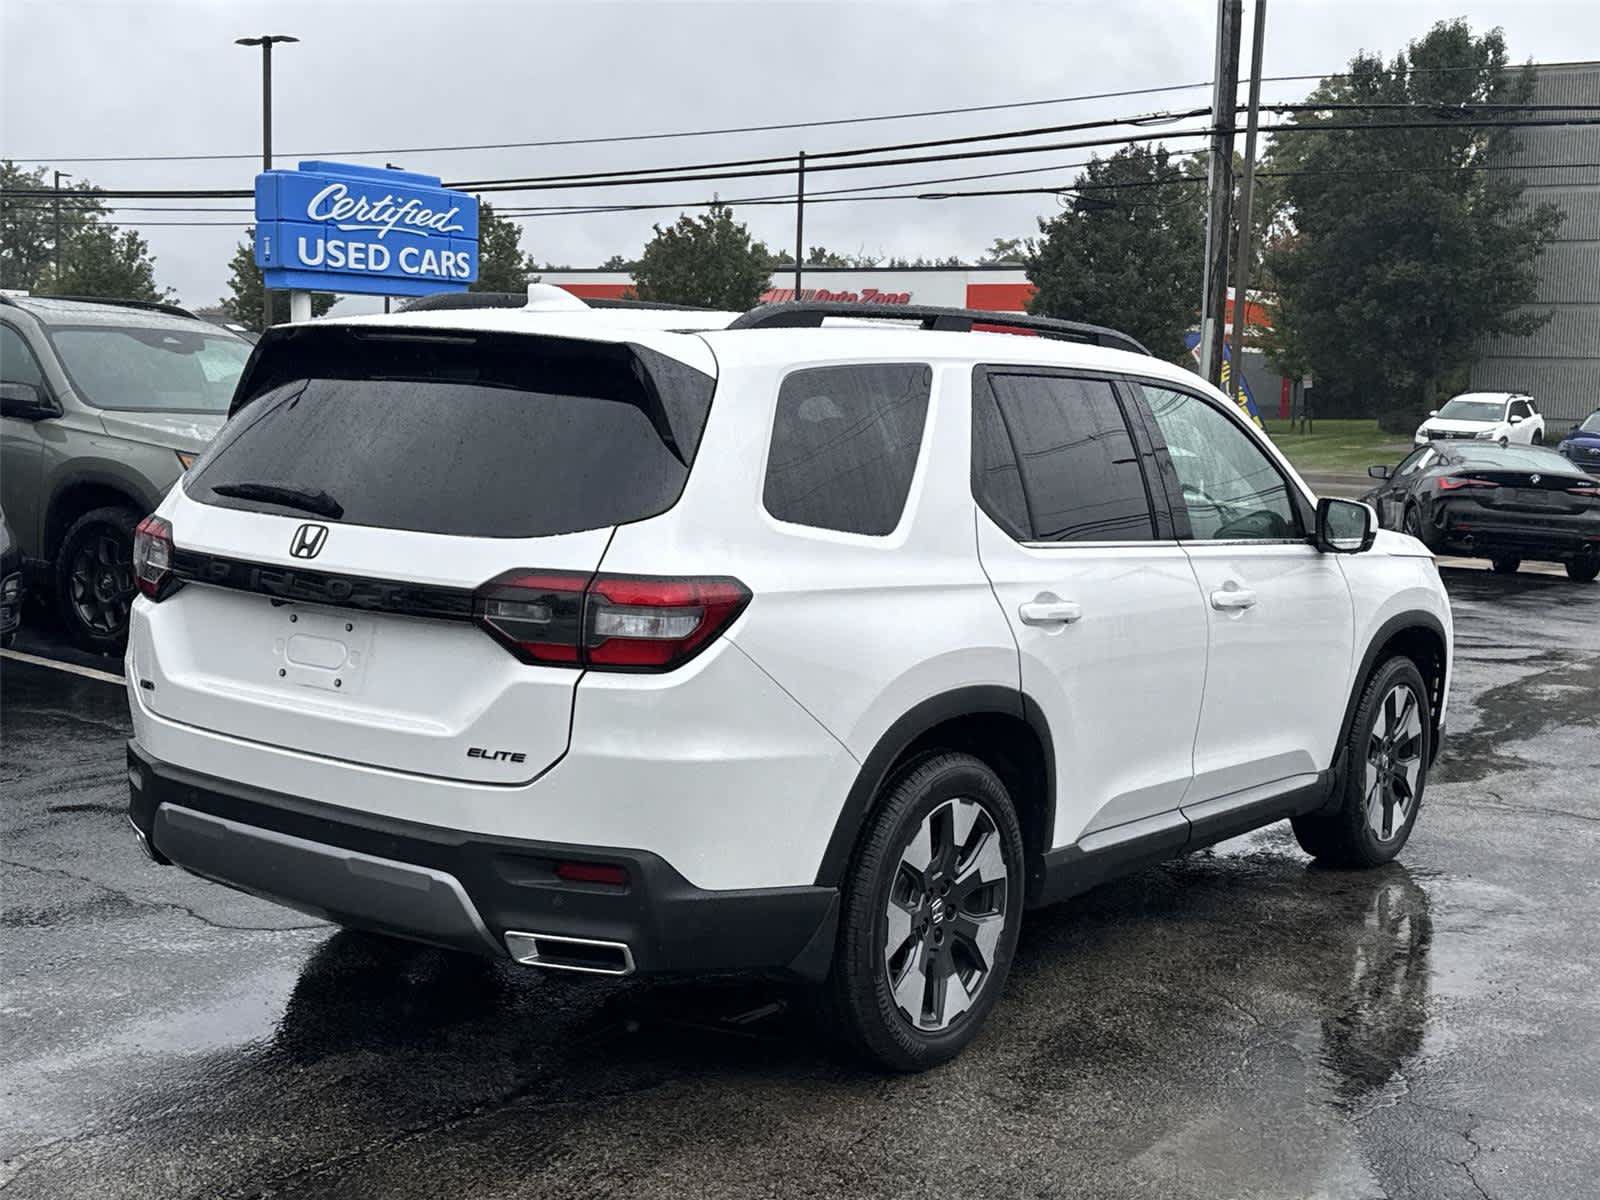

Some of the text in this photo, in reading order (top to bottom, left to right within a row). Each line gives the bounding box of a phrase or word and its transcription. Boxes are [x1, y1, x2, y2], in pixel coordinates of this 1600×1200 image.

[306, 183, 465, 239] Certified
[298, 237, 471, 278] USED CARS
[467, 747, 527, 763] ELITE
